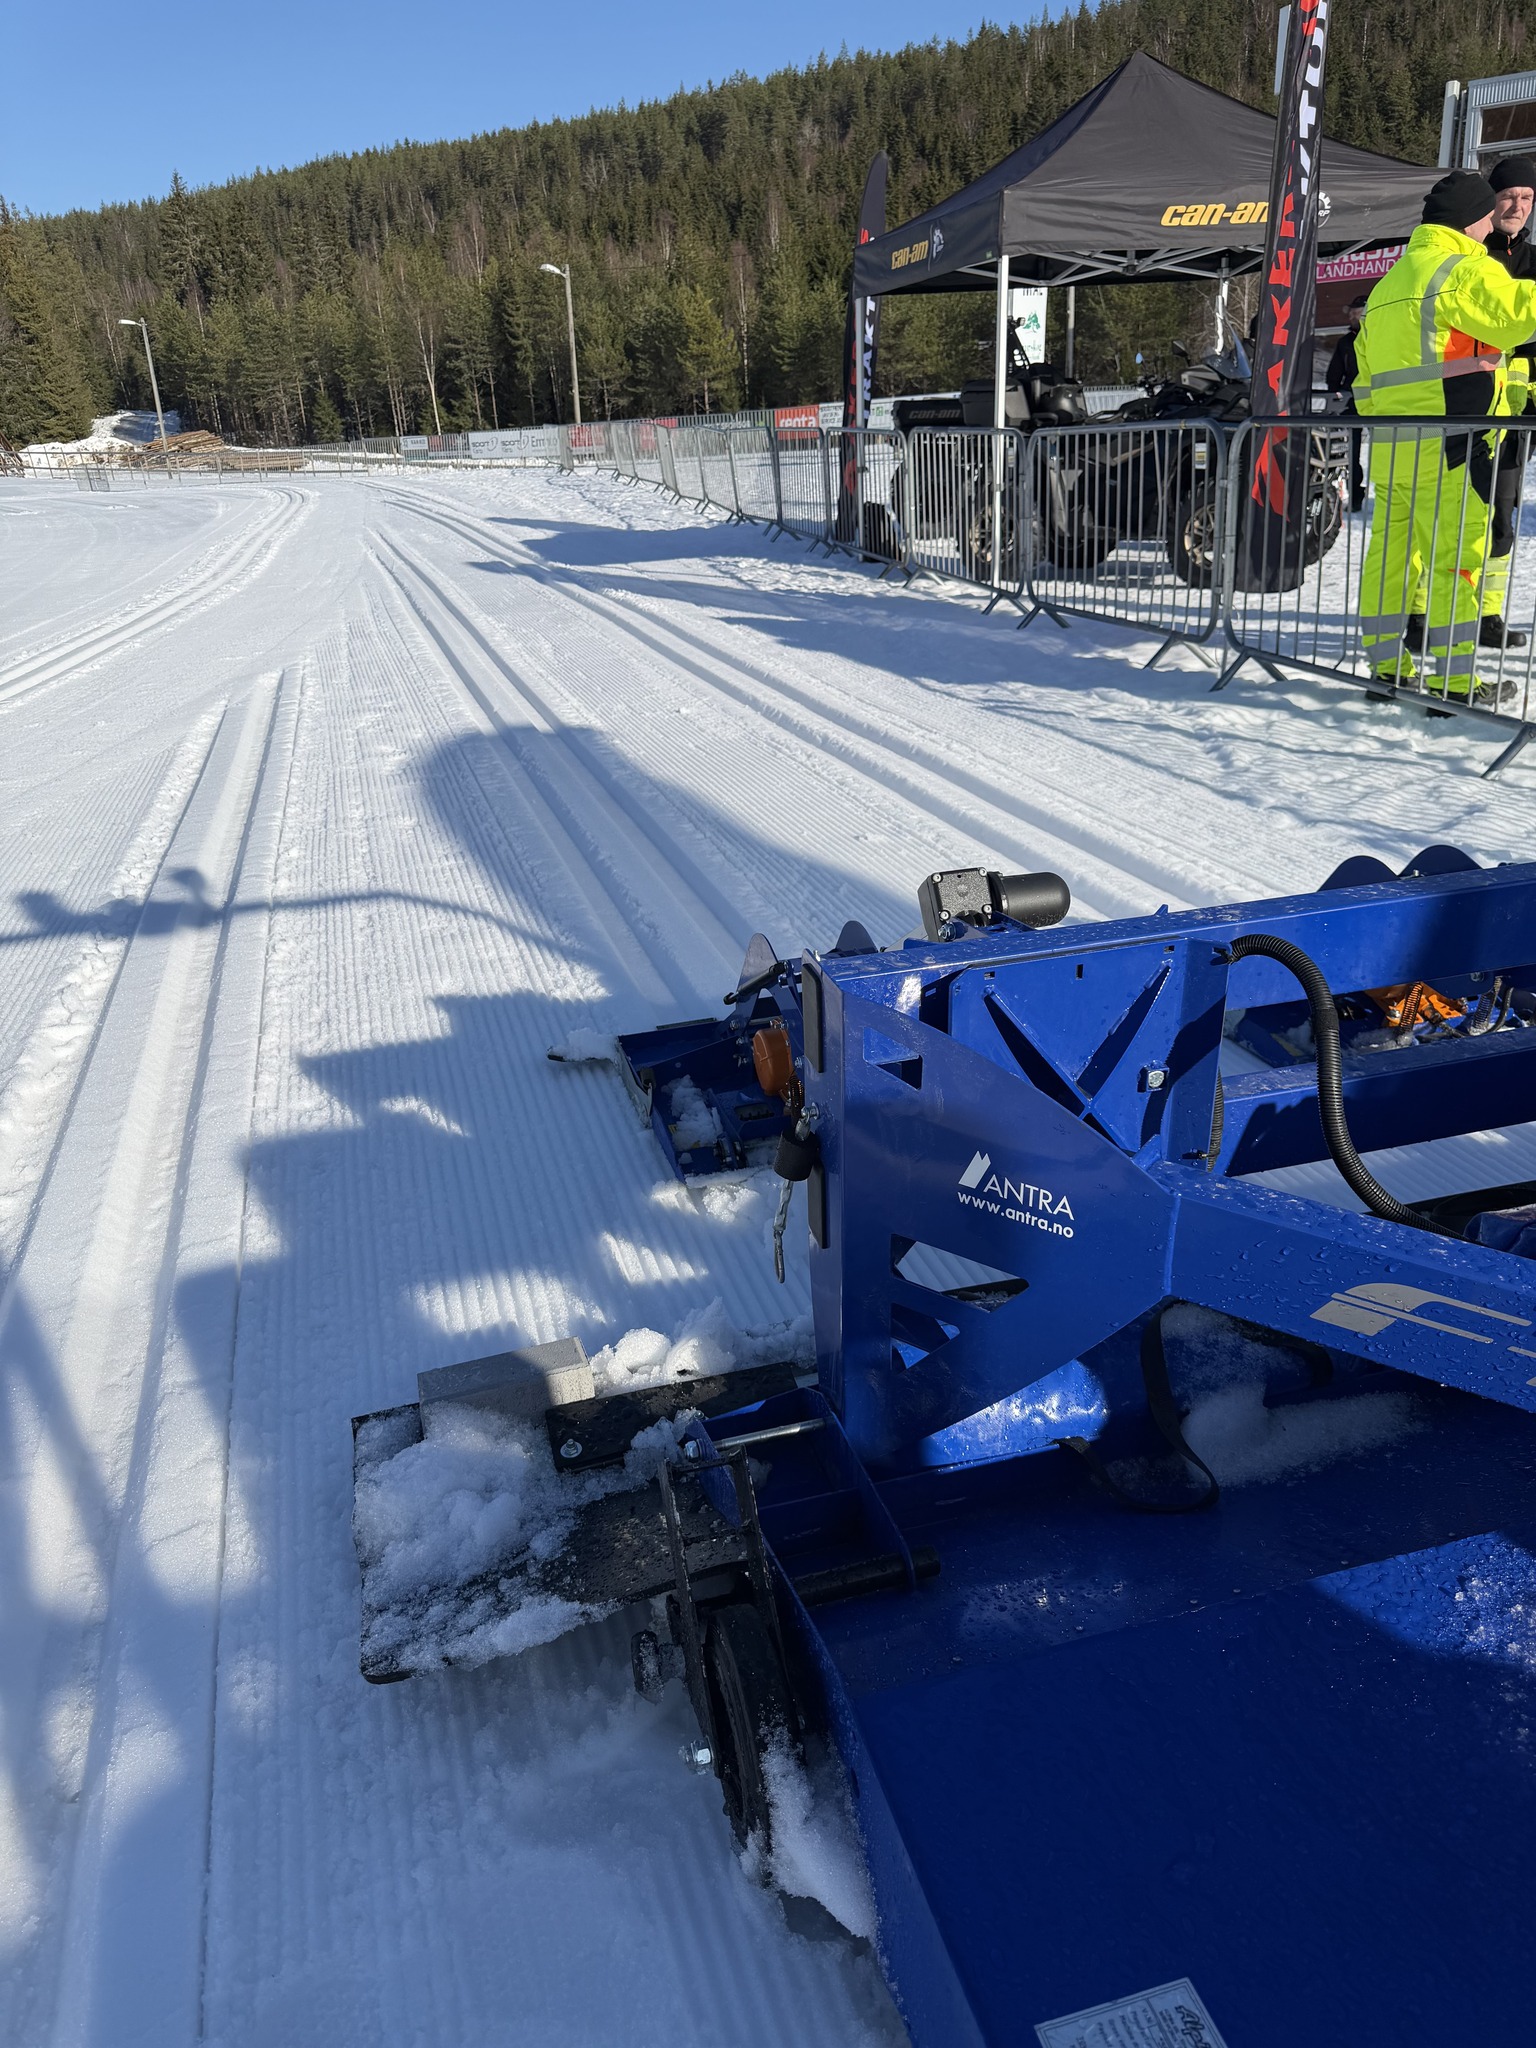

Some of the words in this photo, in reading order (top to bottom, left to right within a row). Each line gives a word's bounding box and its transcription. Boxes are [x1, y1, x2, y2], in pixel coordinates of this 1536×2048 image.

[890, 239, 929, 270] can-am
[779, 414, 816, 428] renta
[908, 409, 961, 419] can-am
[983, 1173, 1075, 1221] ANTRA
[957, 1191, 1074, 1239] www.antra.no
